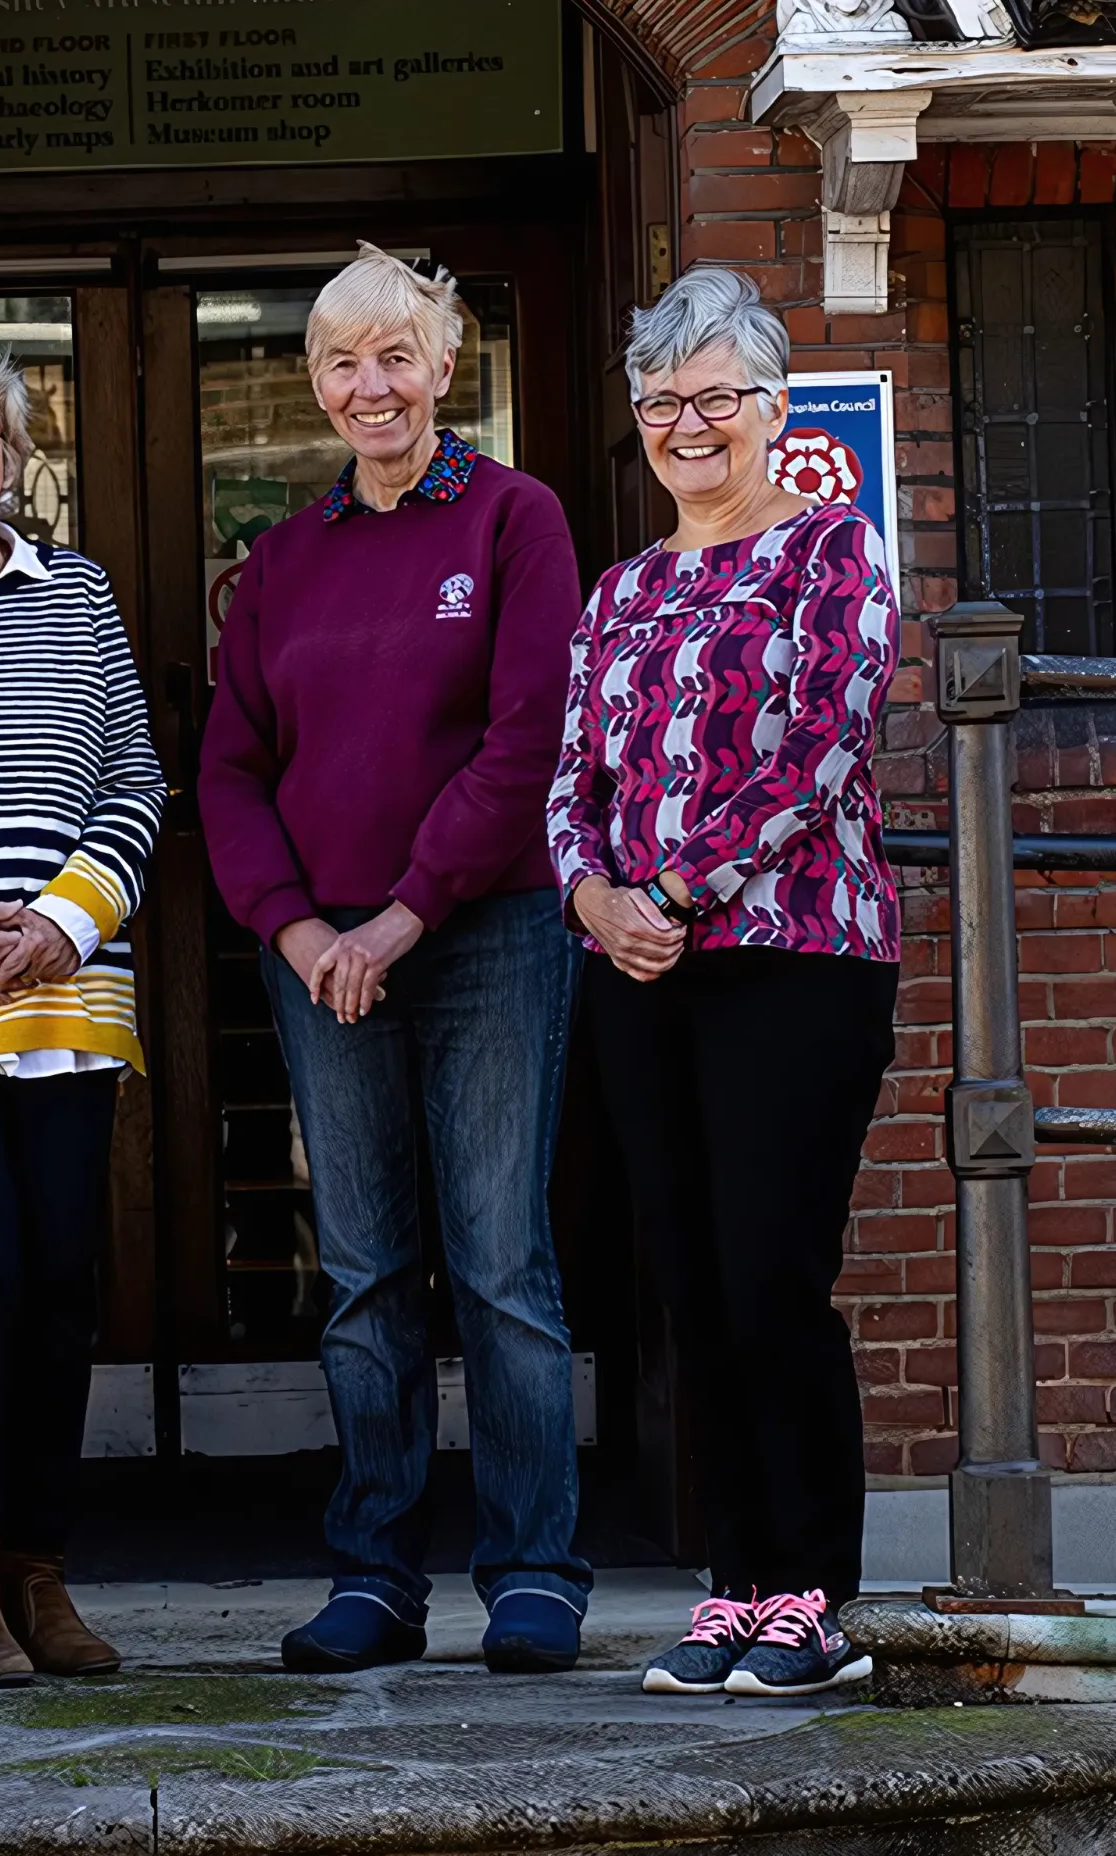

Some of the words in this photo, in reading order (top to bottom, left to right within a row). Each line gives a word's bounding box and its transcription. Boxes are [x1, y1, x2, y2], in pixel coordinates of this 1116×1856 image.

[33, 34, 111, 53] FLOOR
[144, 31, 209, 49] FIRST
[219, 28, 296, 46] FLOOR
[23, 63, 113, 92] history
[145, 57, 282, 82] Exhibition
[291, 55, 339, 77] and
[348, 58, 384, 76] art
[393, 51, 504, 81] galleries
[146, 90, 282, 114] Herkomer
[291, 90, 361, 109] room
[46, 128, 115, 154] maps
[147, 122, 259, 146] Museum
[266, 119, 331, 147] shop
